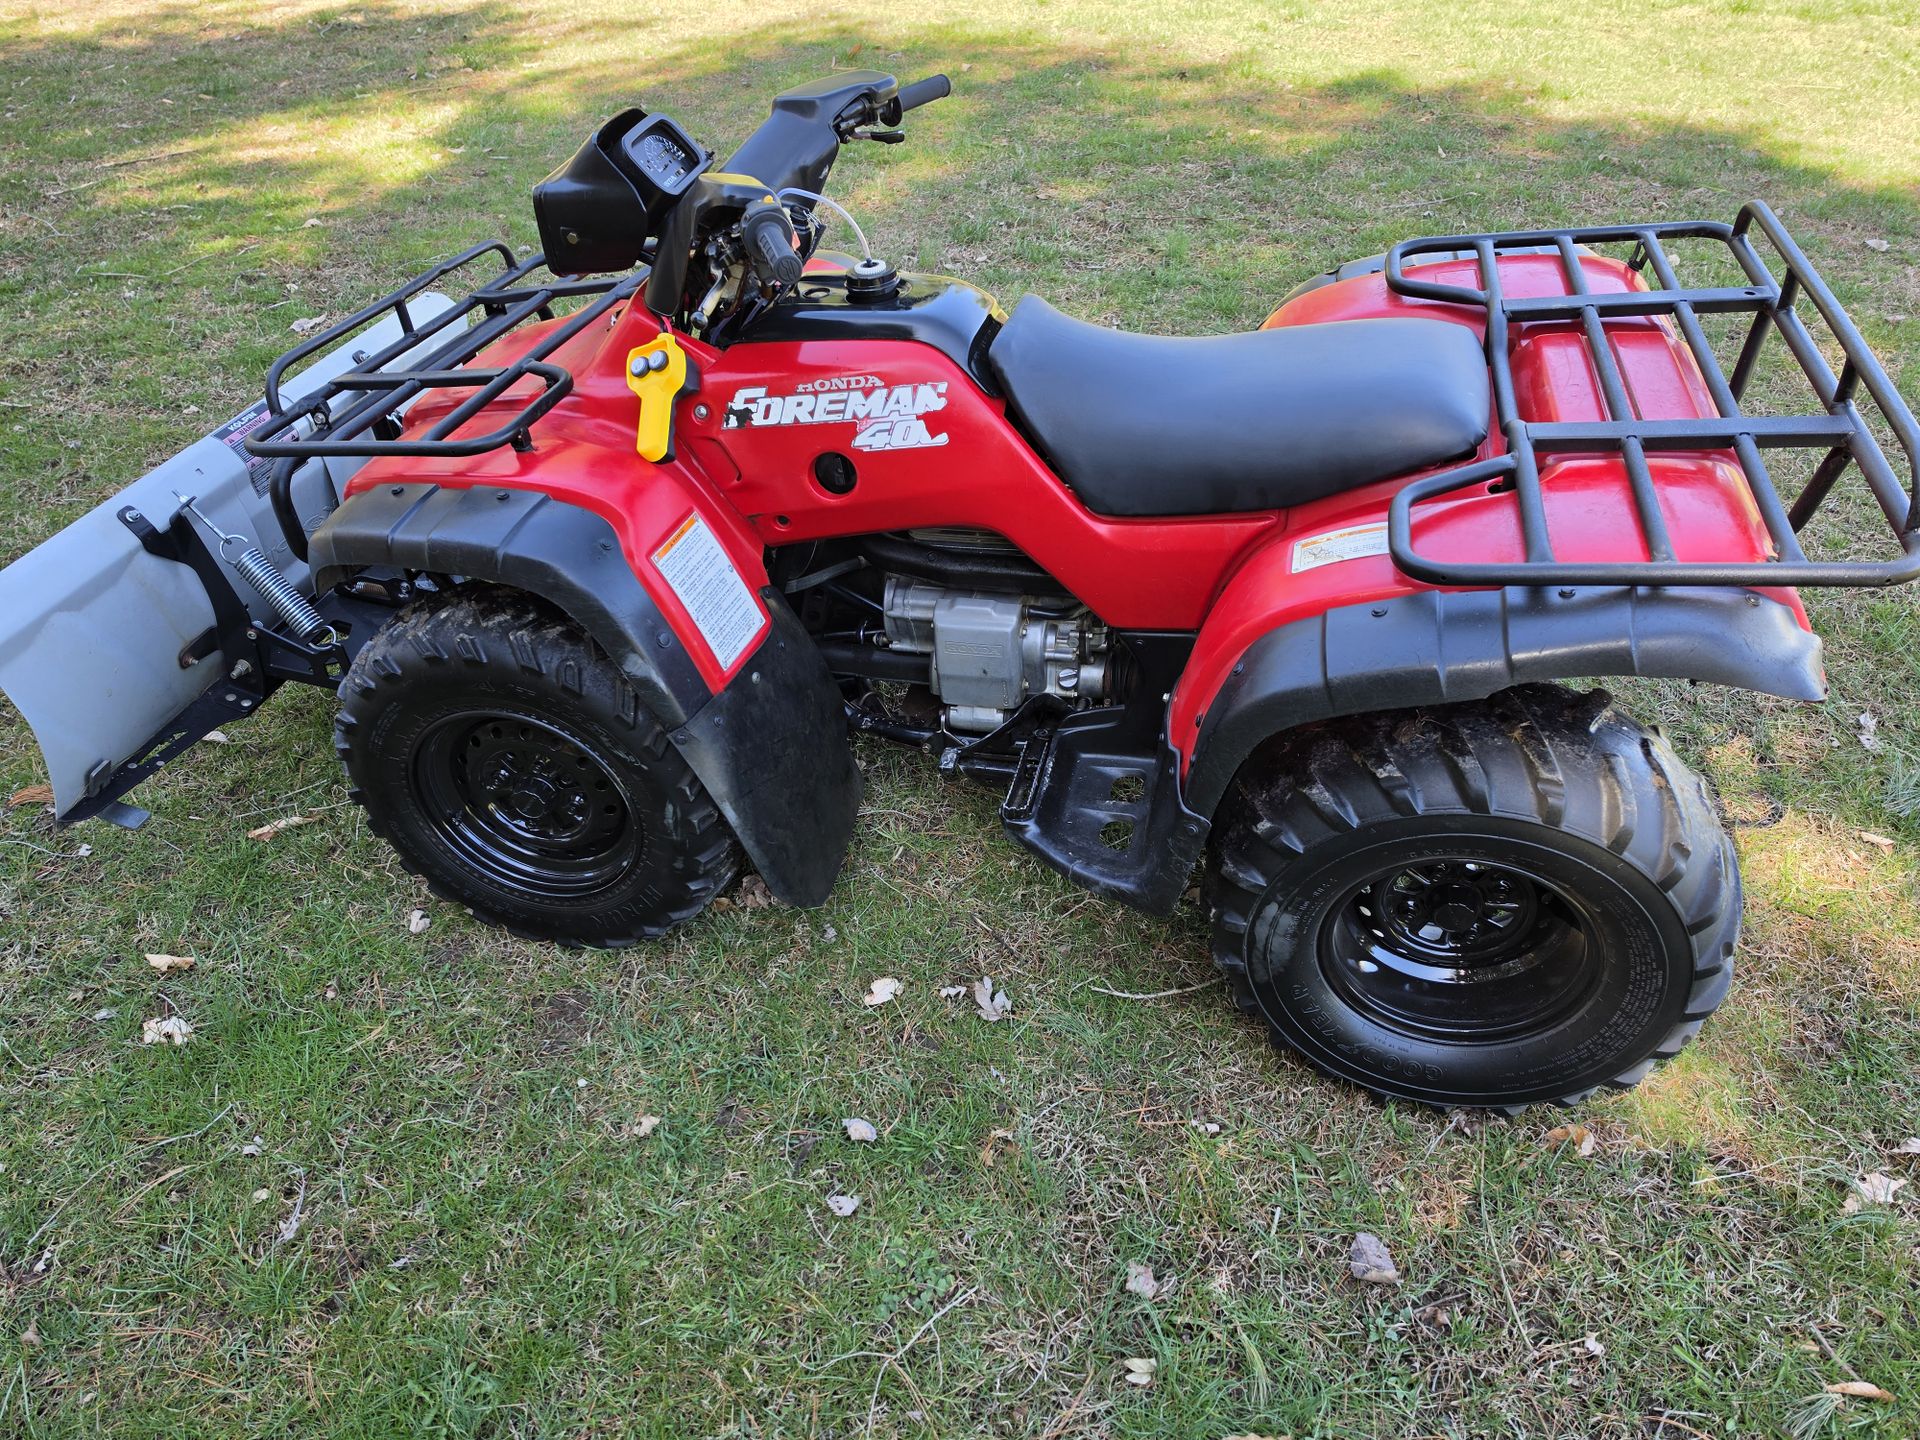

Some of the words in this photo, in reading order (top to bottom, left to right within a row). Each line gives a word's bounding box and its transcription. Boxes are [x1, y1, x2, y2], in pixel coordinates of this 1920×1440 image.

[227, 411, 257, 431] KOLPIN
[237, 416, 266, 436] WARNING
[1291, 984, 1444, 1081] GOODYEAR
